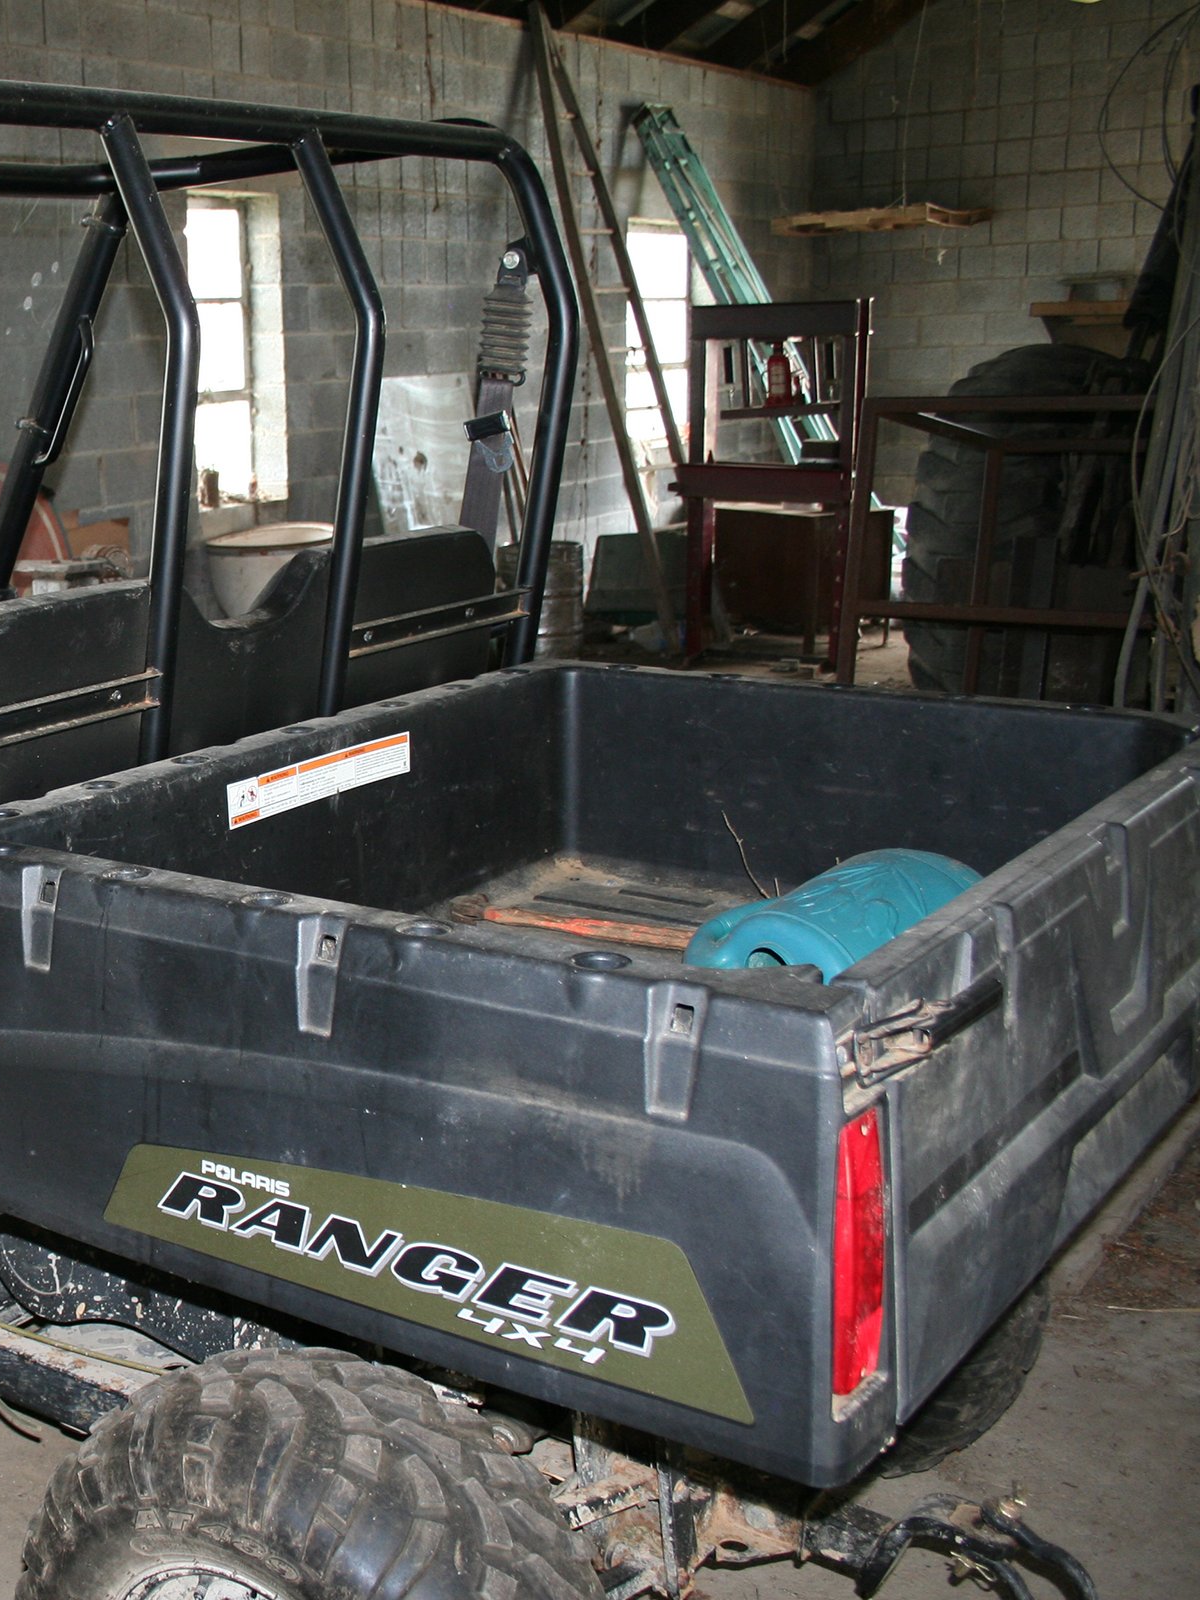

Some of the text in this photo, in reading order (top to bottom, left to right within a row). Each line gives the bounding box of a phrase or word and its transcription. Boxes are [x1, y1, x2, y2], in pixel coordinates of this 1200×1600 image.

[201, 1159, 290, 1197] POLARIS
[157, 1171, 676, 1358] RANGER
[457, 1308, 606, 1364] 4X4
